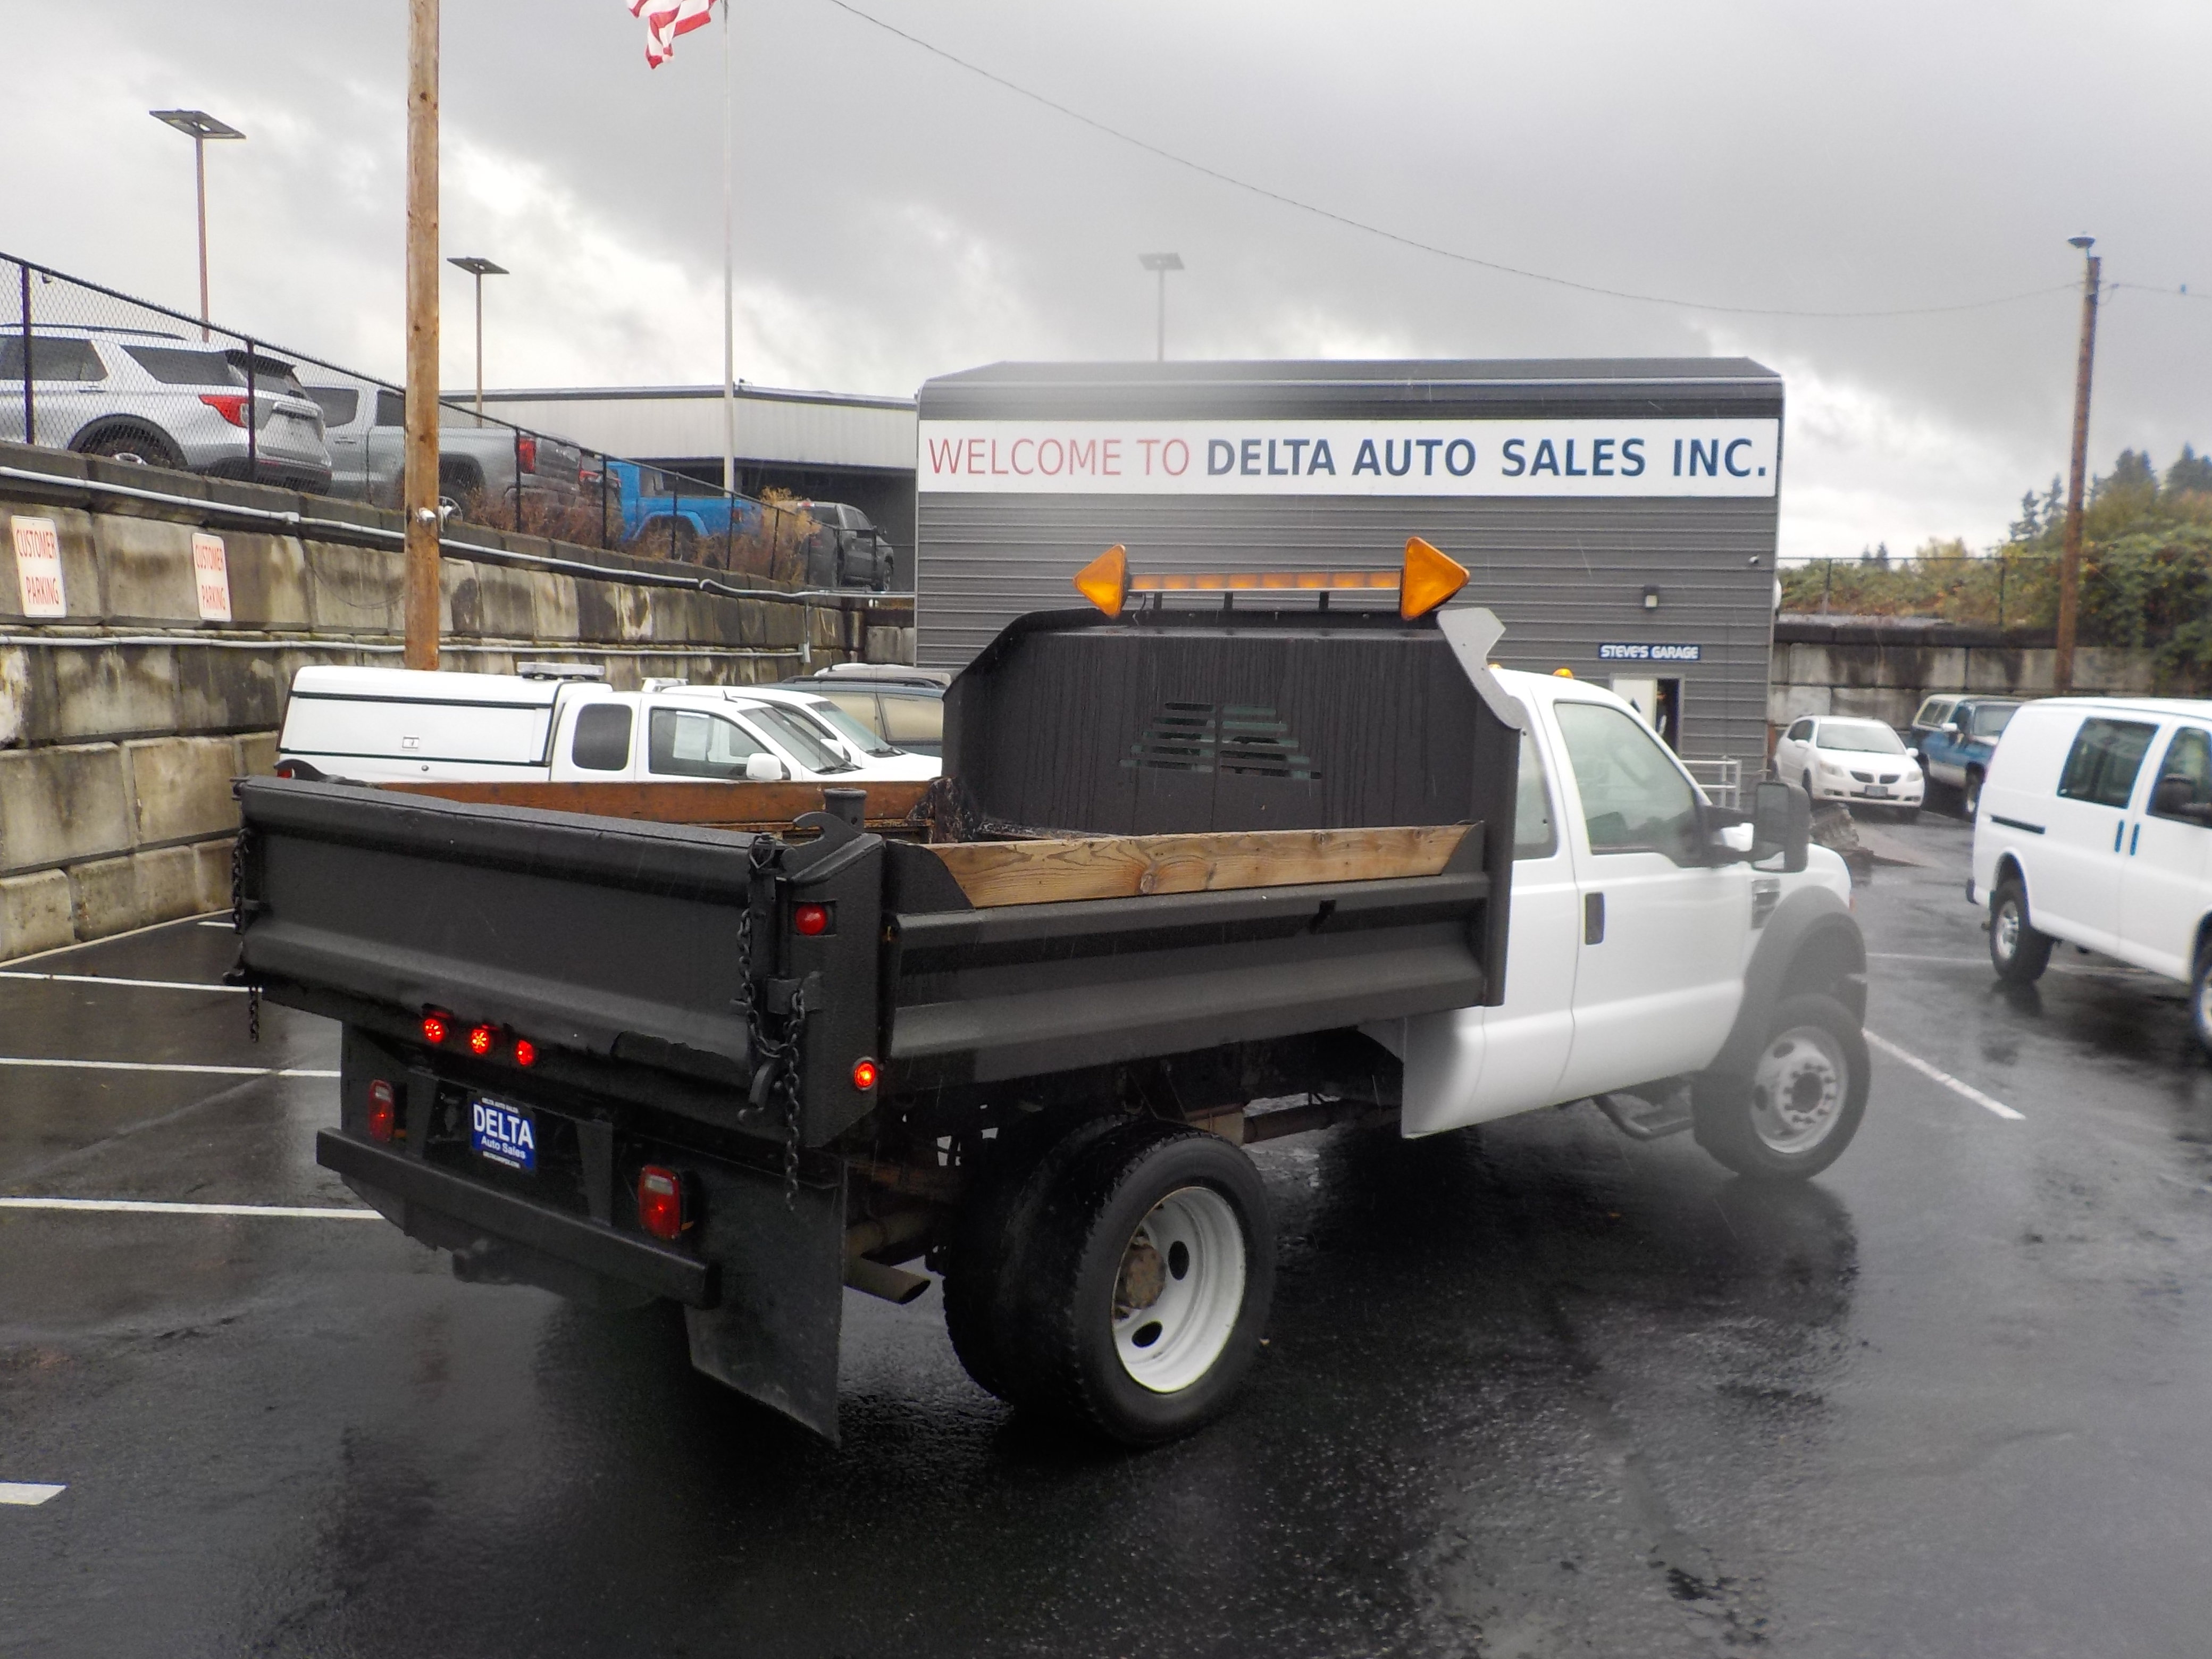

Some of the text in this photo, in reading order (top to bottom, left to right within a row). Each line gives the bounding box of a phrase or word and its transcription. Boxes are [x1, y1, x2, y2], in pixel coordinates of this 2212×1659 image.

[928, 438, 1766, 476] WELCOME TO DELTA AUTO SALES INC.
[16, 529, 57, 559] CUSTOMER
[195, 544, 224, 571] CUSTOMER
[26, 576, 59, 605] PARKING
[202, 584, 225, 610] PARKING
[1601, 644, 1699, 659] STEVE'S GARAGE
[473, 1103, 534, 1149] DELTA
[481, 1135, 526, 1159] Auto Sales
